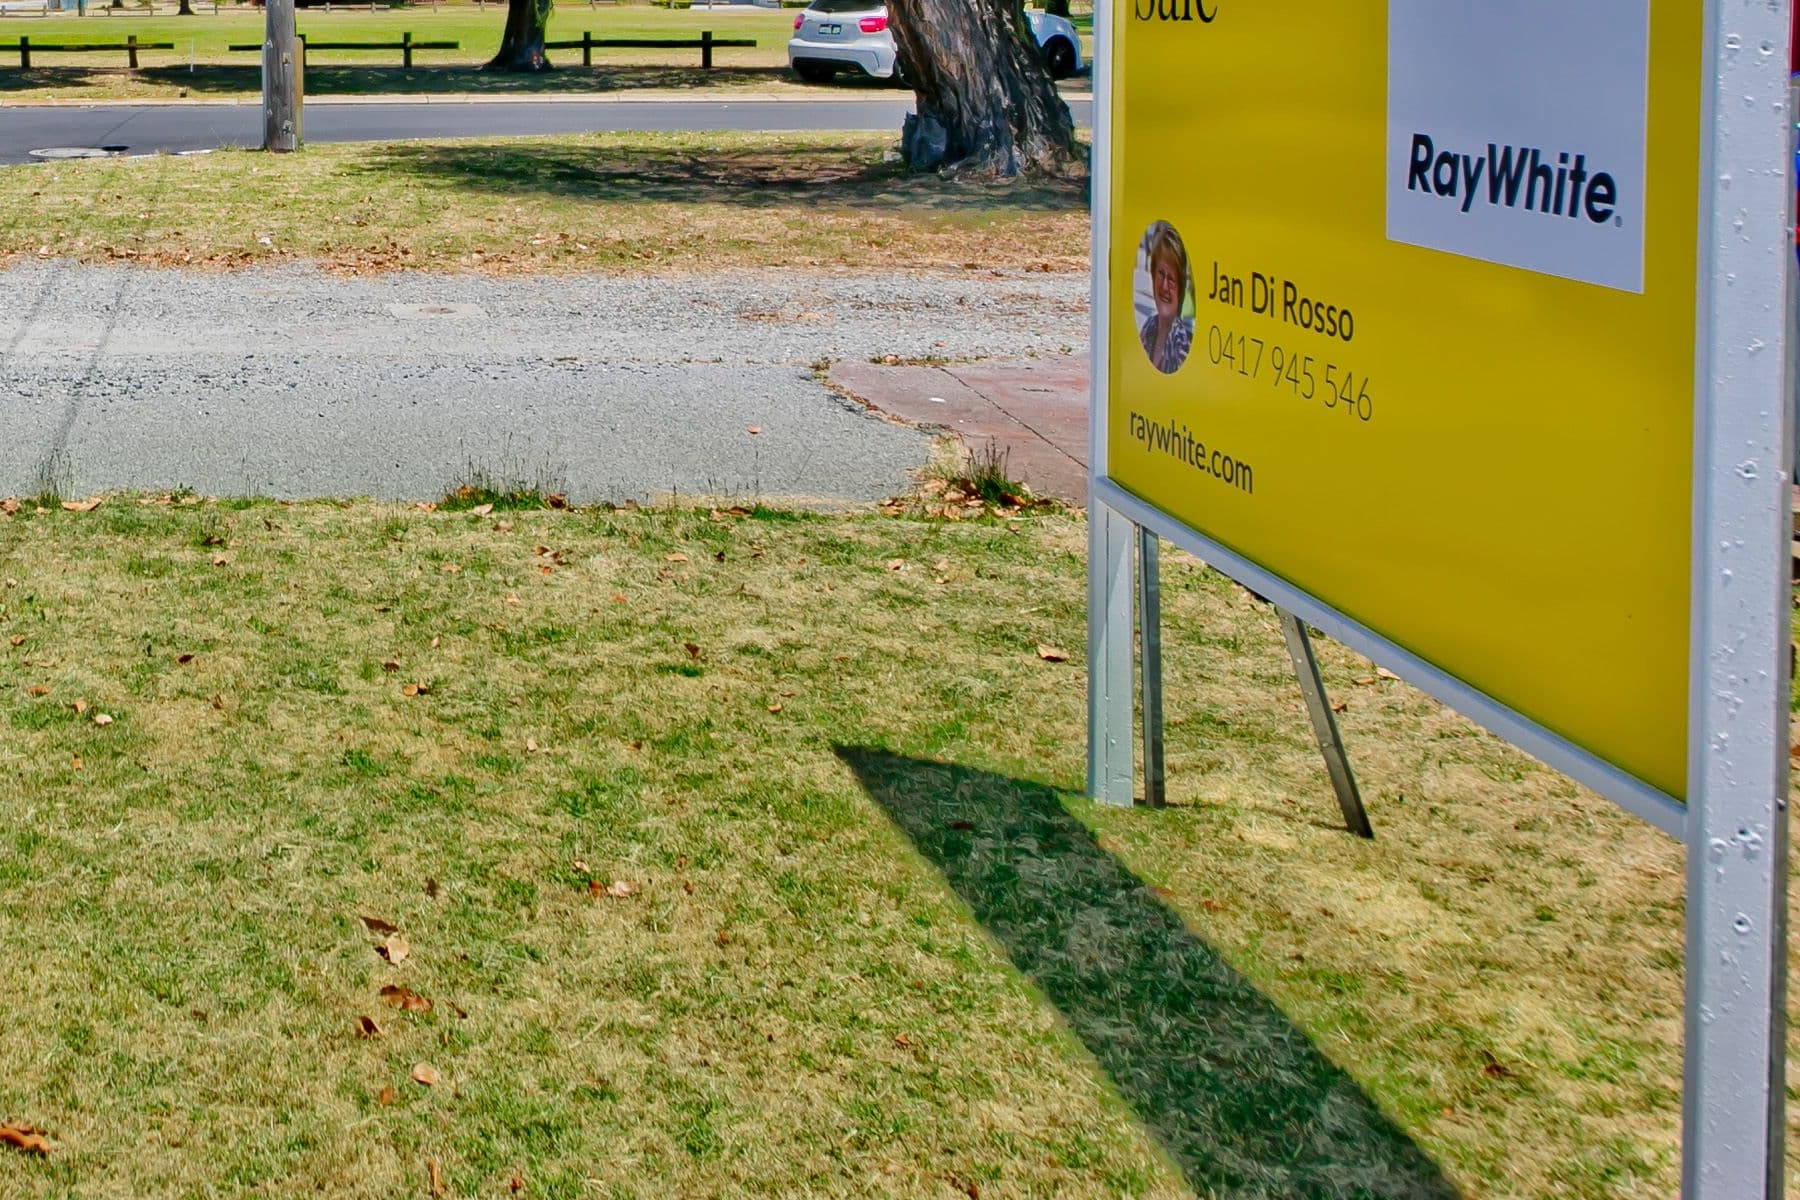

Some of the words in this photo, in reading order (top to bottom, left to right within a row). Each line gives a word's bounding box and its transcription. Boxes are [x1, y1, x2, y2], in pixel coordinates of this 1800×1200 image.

[1208, 261, 1244, 310] Jan
[1251, 271, 1276, 320] Di
[1283, 279, 1355, 343] Rosso
[1208, 324, 1265, 380] 0417
[1271, 345, 1316, 401] 945
[1324, 363, 1374, 423] 546
[1130, 409, 1254, 496] raywhite.com
